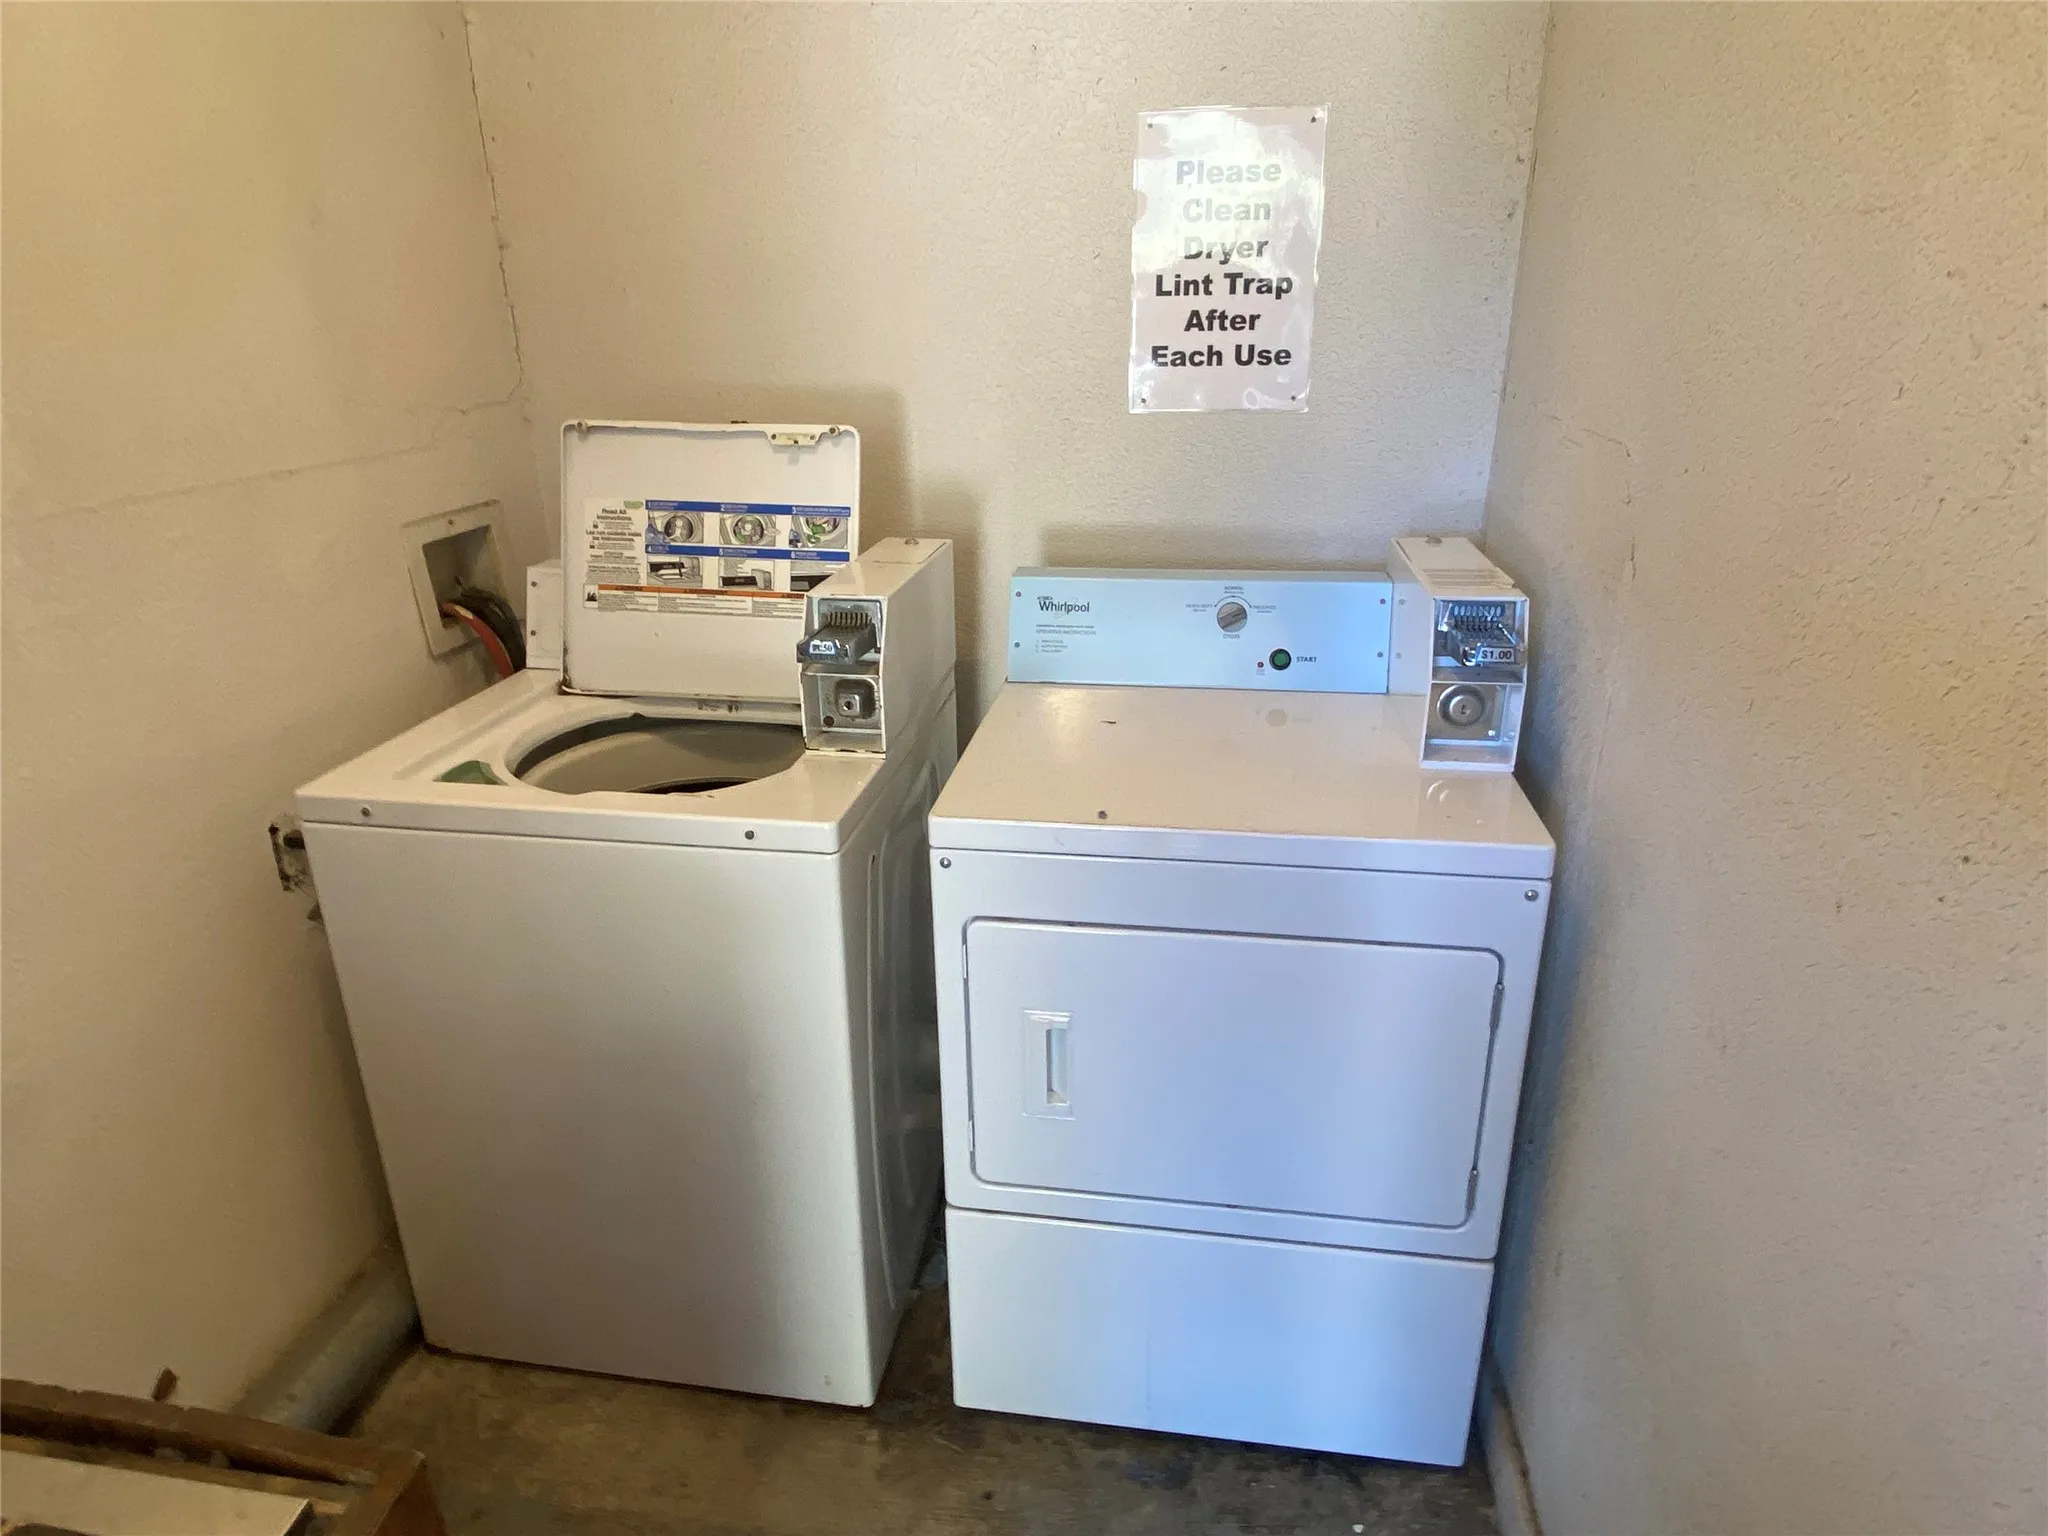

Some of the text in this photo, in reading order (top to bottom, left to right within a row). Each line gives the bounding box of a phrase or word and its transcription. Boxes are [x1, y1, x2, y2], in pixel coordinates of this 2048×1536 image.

[1176, 160, 1282, 185] Please
[1182, 198, 1272, 222] Clean
[1184, 236, 1269, 265] Dryer
[1155, 272, 1294, 300] Lint Trap
[1184, 309, 1261, 332] After
[1151, 344, 1292, 367] Each Use
[1038, 600, 1090, 615] Whirlpool
[1481, 649, 1512, 661] $1.00
